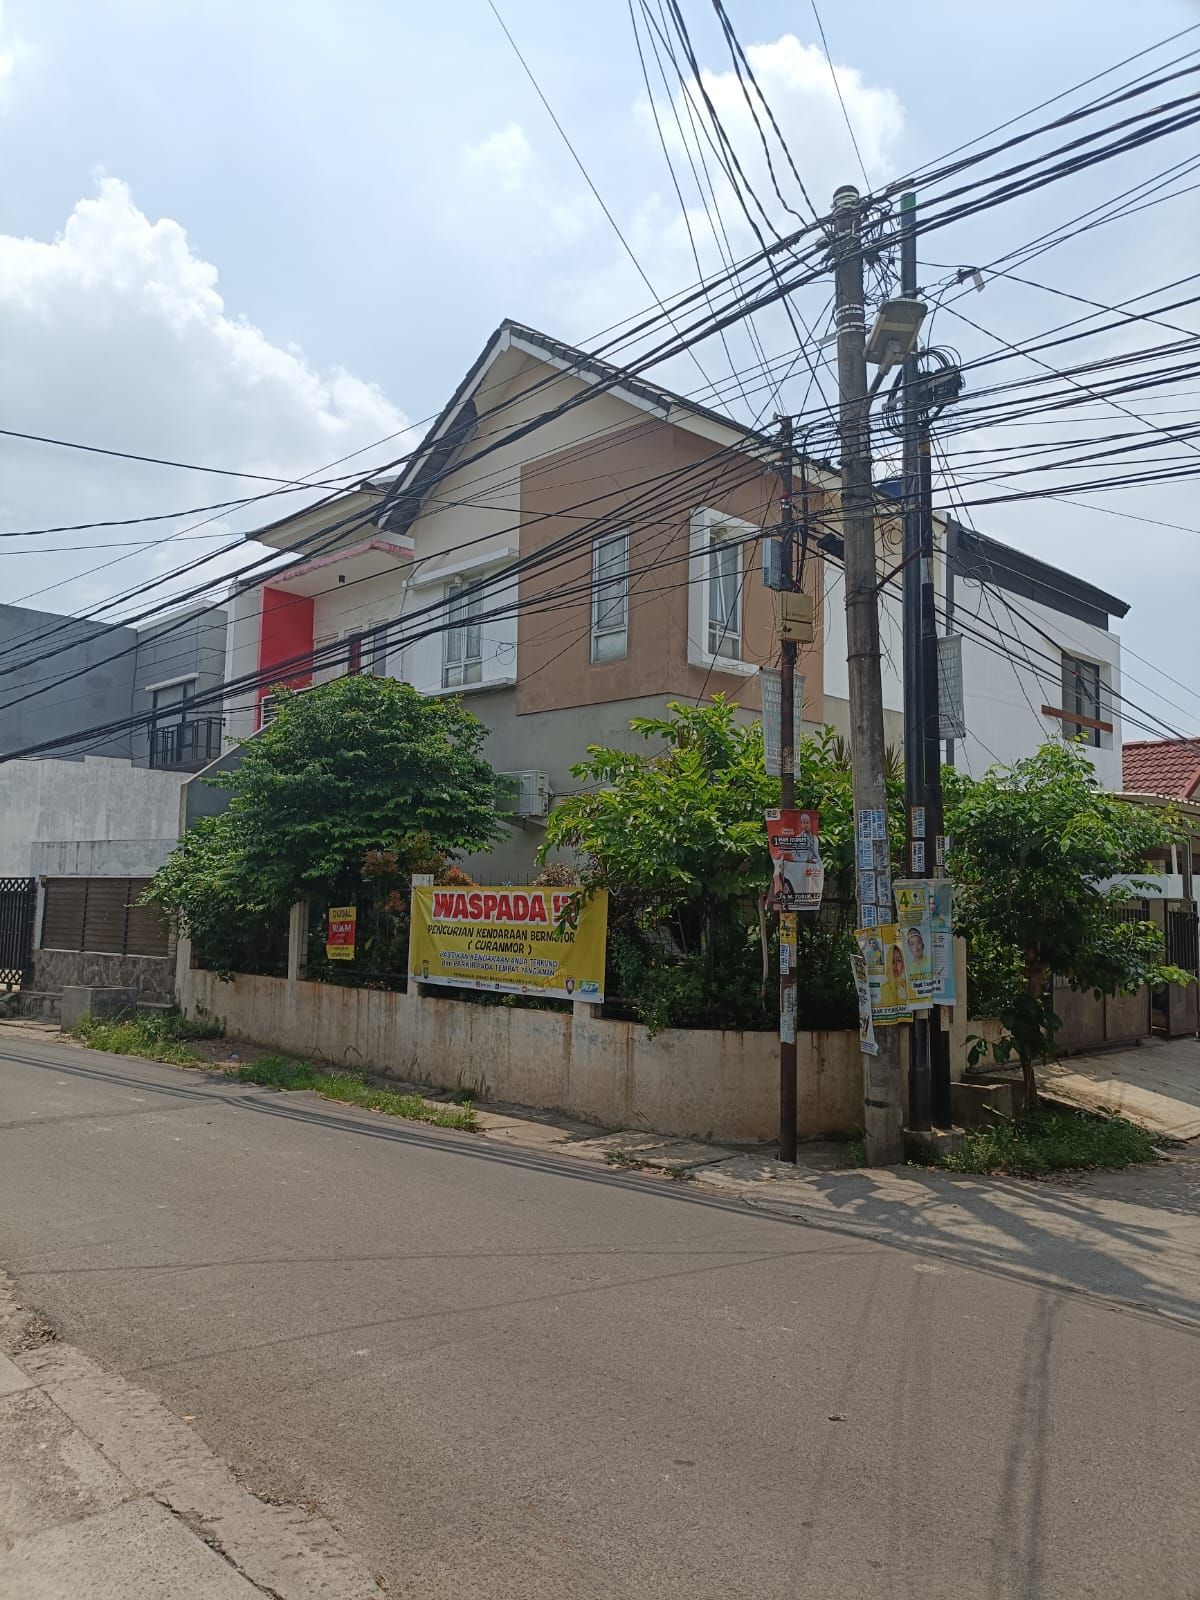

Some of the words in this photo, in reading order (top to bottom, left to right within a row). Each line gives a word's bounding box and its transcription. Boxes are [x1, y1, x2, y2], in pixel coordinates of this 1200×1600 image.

[899, 891, 910, 908] 4
[332, 908, 353, 918] DIJUAL
[432, 893, 547, 923] WASPADA
[427, 925, 474, 938] PENCURIAN
[476, 928, 528, 941] KENDARAAN
[474, 941, 525, 953] CURANMOR
